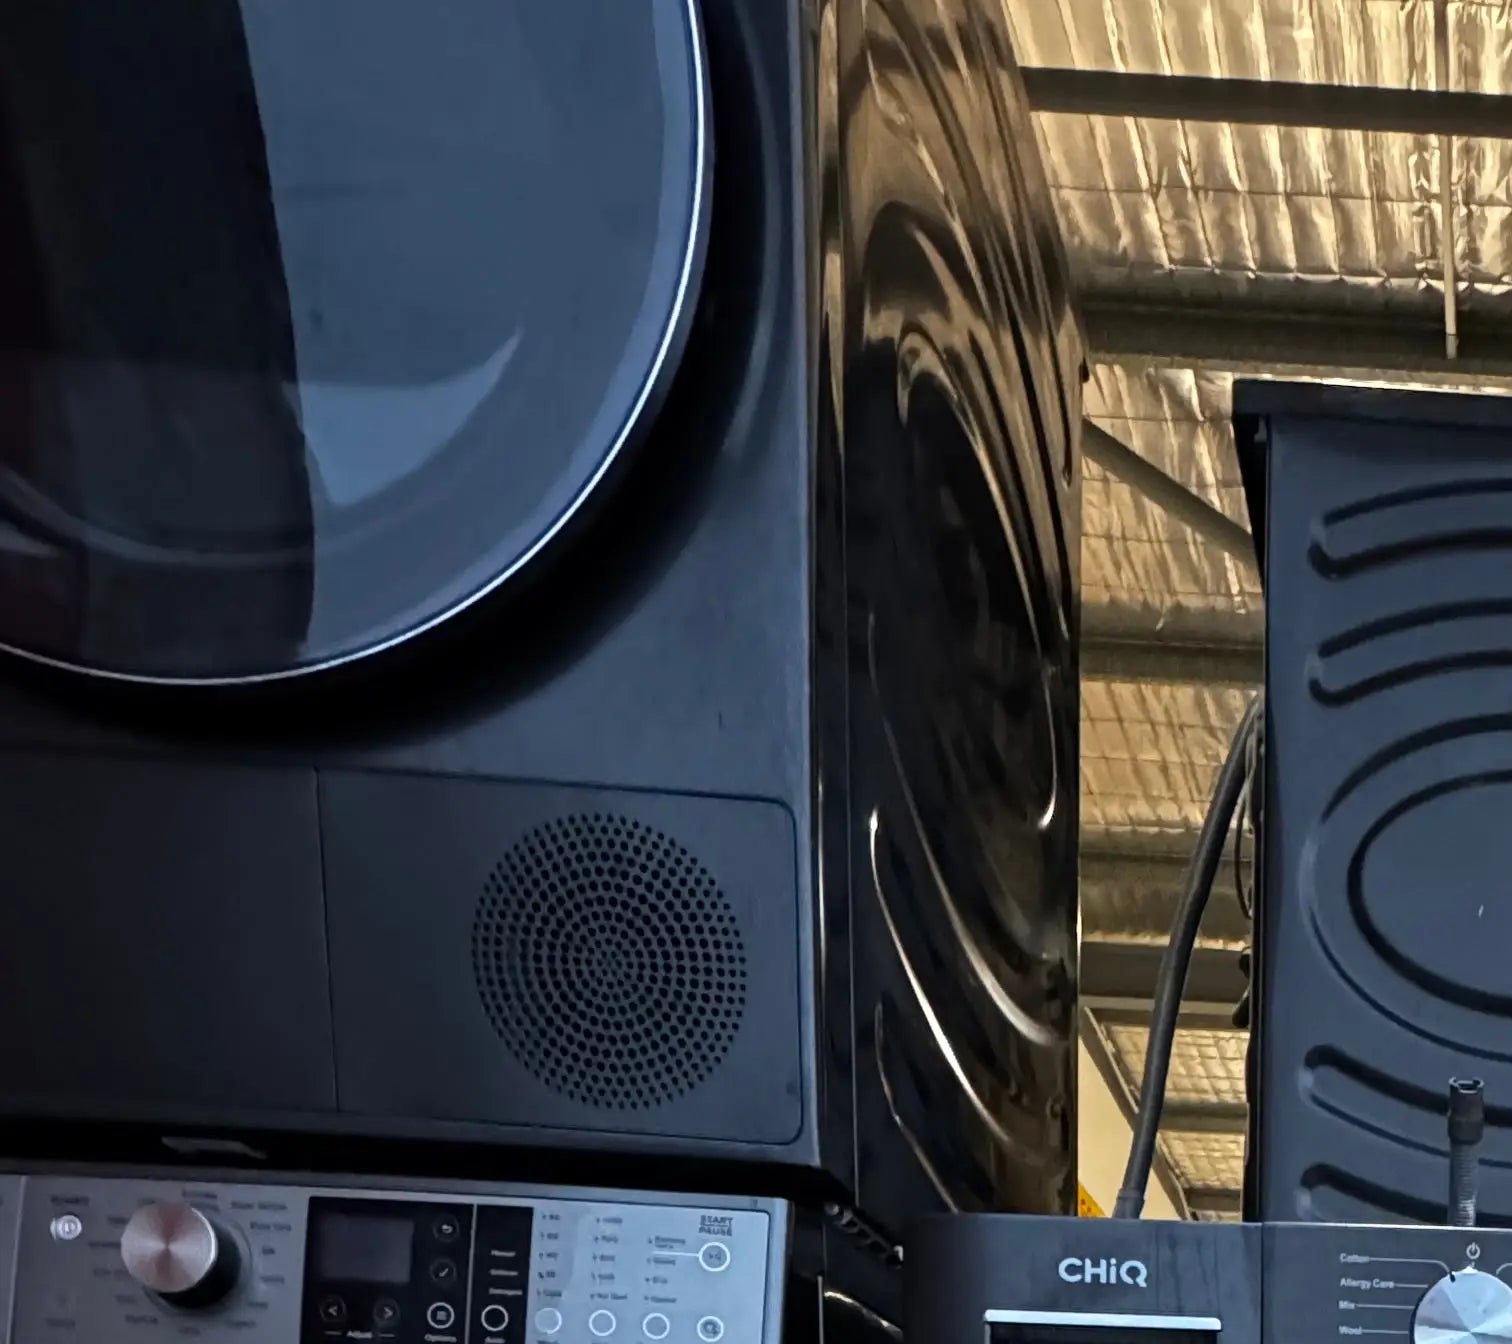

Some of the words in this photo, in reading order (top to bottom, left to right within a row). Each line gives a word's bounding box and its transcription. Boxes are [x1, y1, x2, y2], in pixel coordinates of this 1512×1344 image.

[1058, 1257, 1147, 1287] CHiQ
[1340, 1278, 1371, 1290] Allergy
[1372, 1279, 1395, 1288] Care
